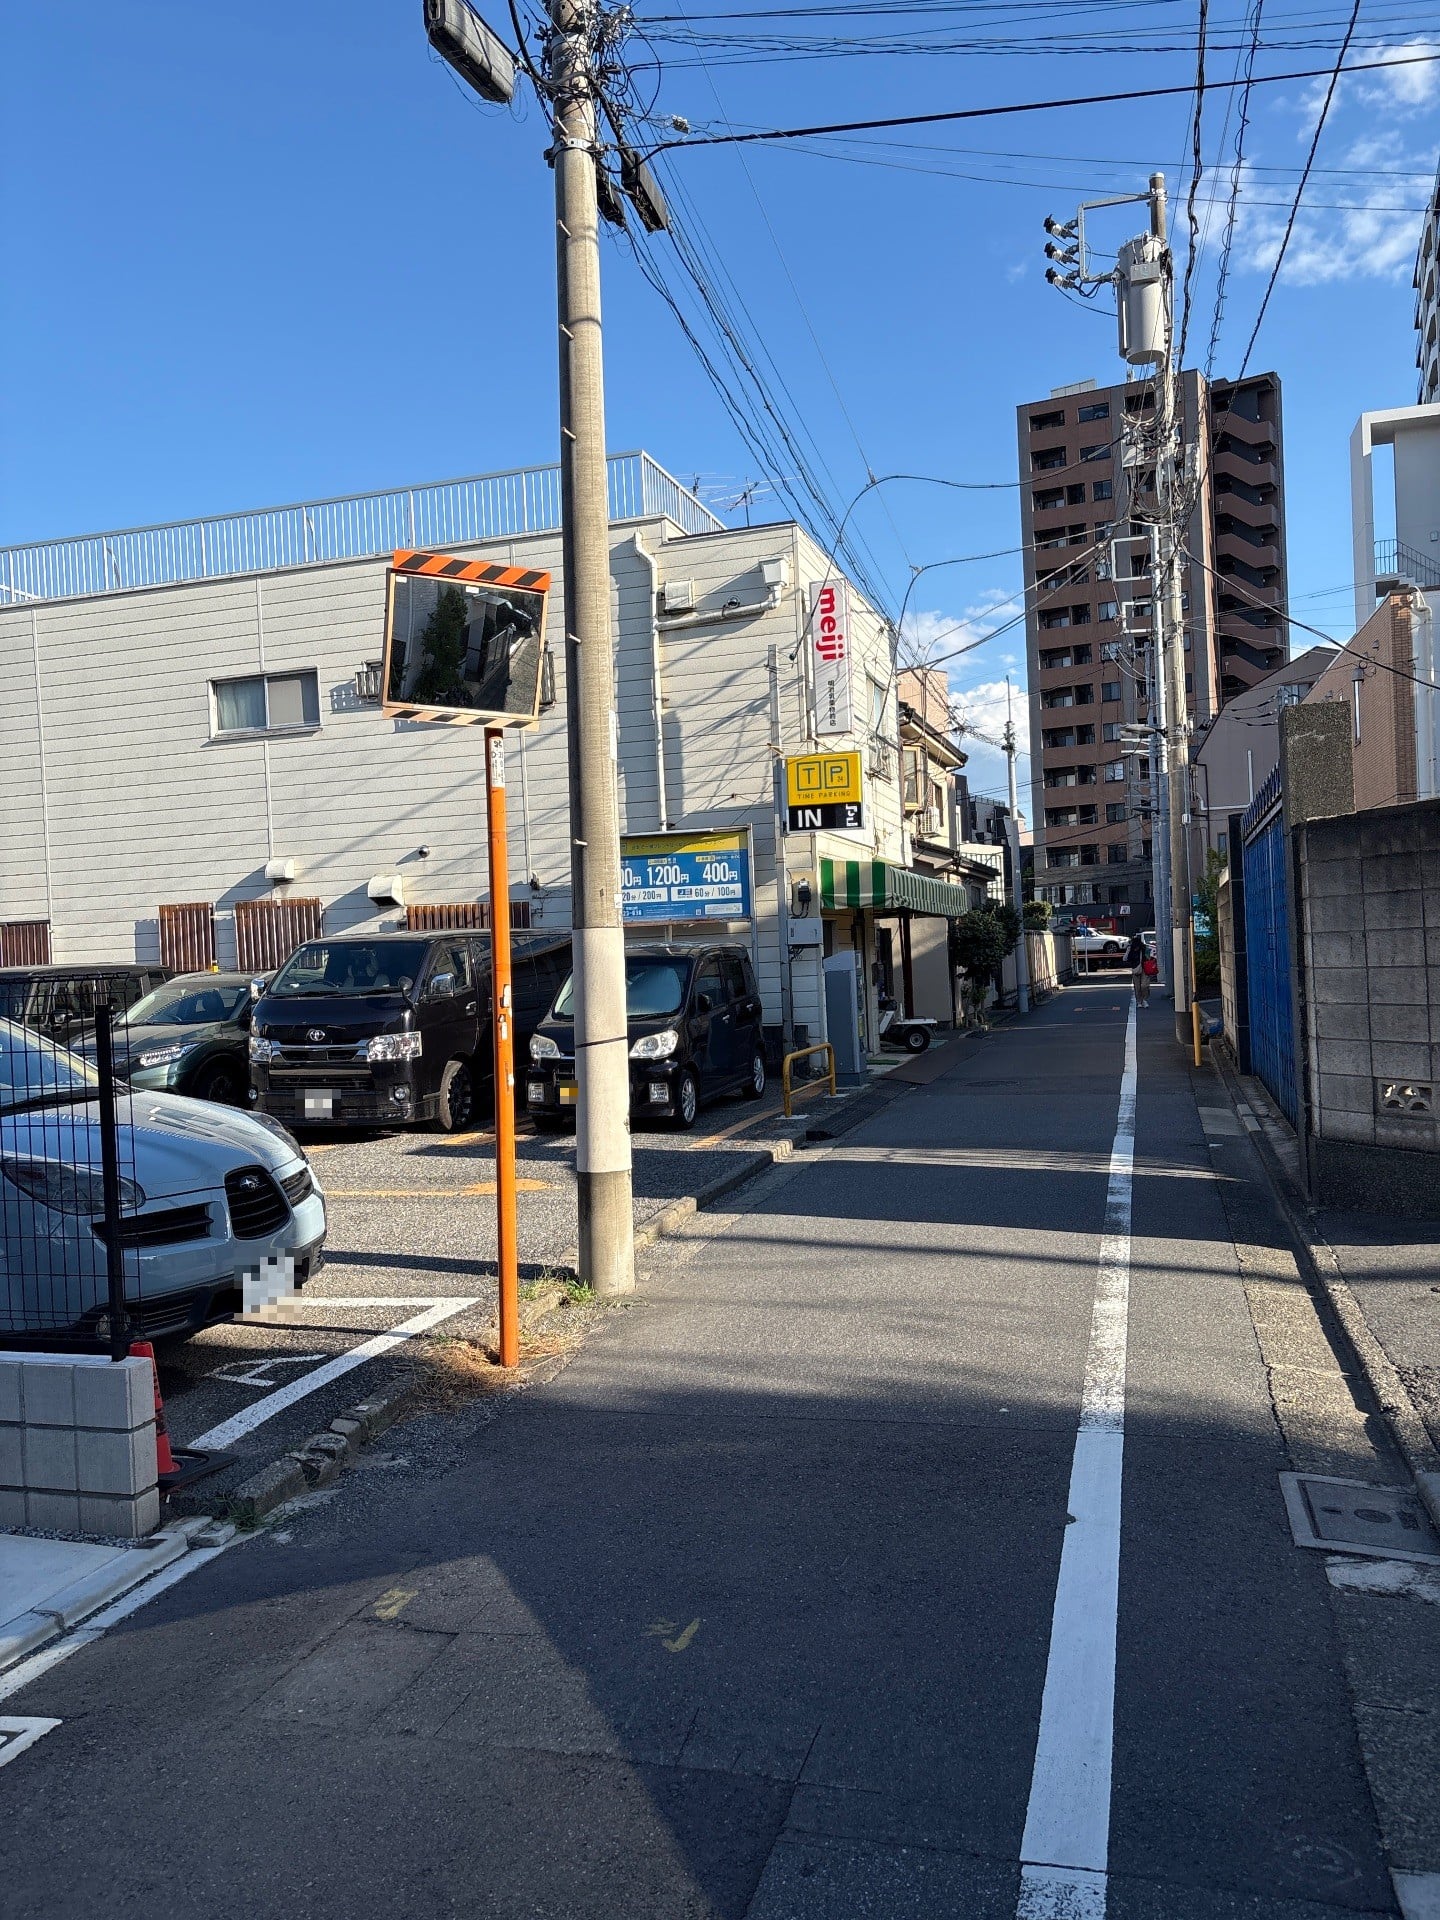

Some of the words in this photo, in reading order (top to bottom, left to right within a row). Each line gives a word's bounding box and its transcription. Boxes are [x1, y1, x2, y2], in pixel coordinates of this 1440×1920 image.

[816, 587, 844, 661] meiji
[797, 808, 822, 828] IN
[702, 862, 738, 883] 400円
